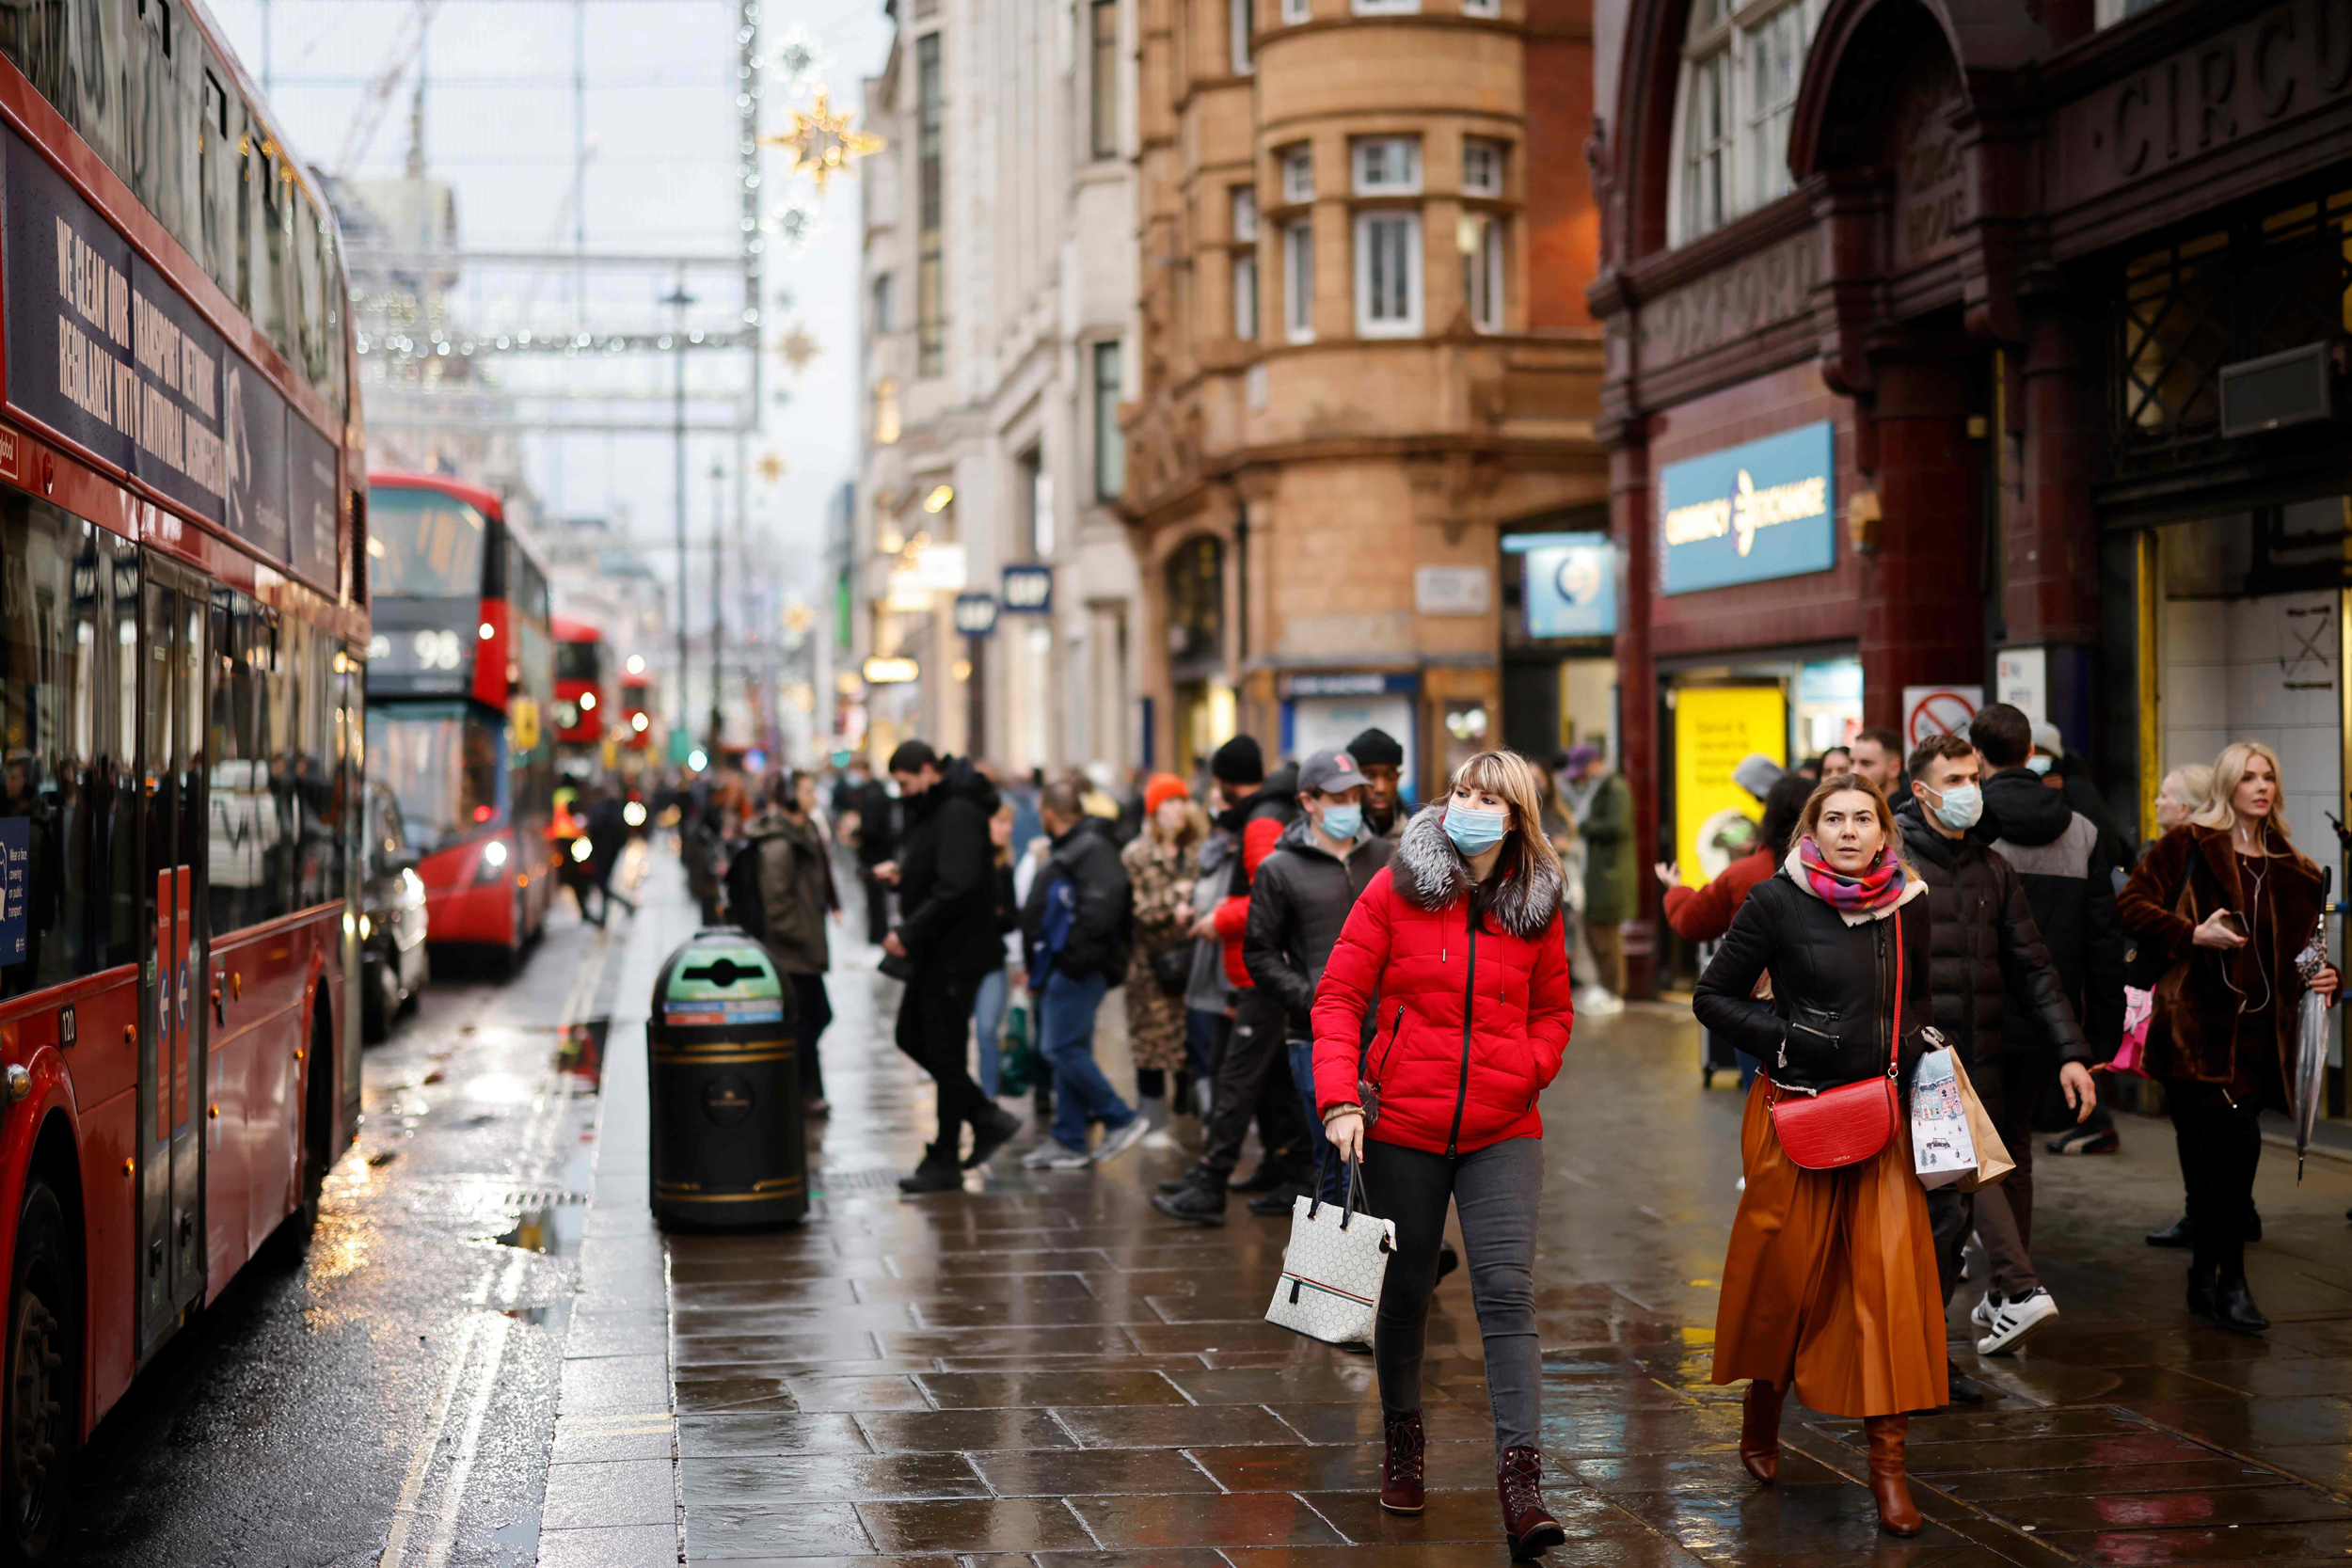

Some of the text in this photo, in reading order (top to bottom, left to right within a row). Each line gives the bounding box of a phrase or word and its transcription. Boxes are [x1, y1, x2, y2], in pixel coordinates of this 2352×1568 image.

[56, 215, 73, 306] WE
[75, 234, 105, 332] CLEAN
[108, 265, 130, 350] OUR
[133, 288, 181, 391] TRANSPORT
[58, 314, 112, 426] REGULARLY
[115, 358, 140, 446] WITH
[143, 381, 185, 474] ANTIVIRAL
[415, 628, 461, 671] 98
[8, 866, 23, 882] covering
[13, 884, 23, 901] public
[8, 905, 23, 920] transport
[62, 1008, 75, 1042] 120
